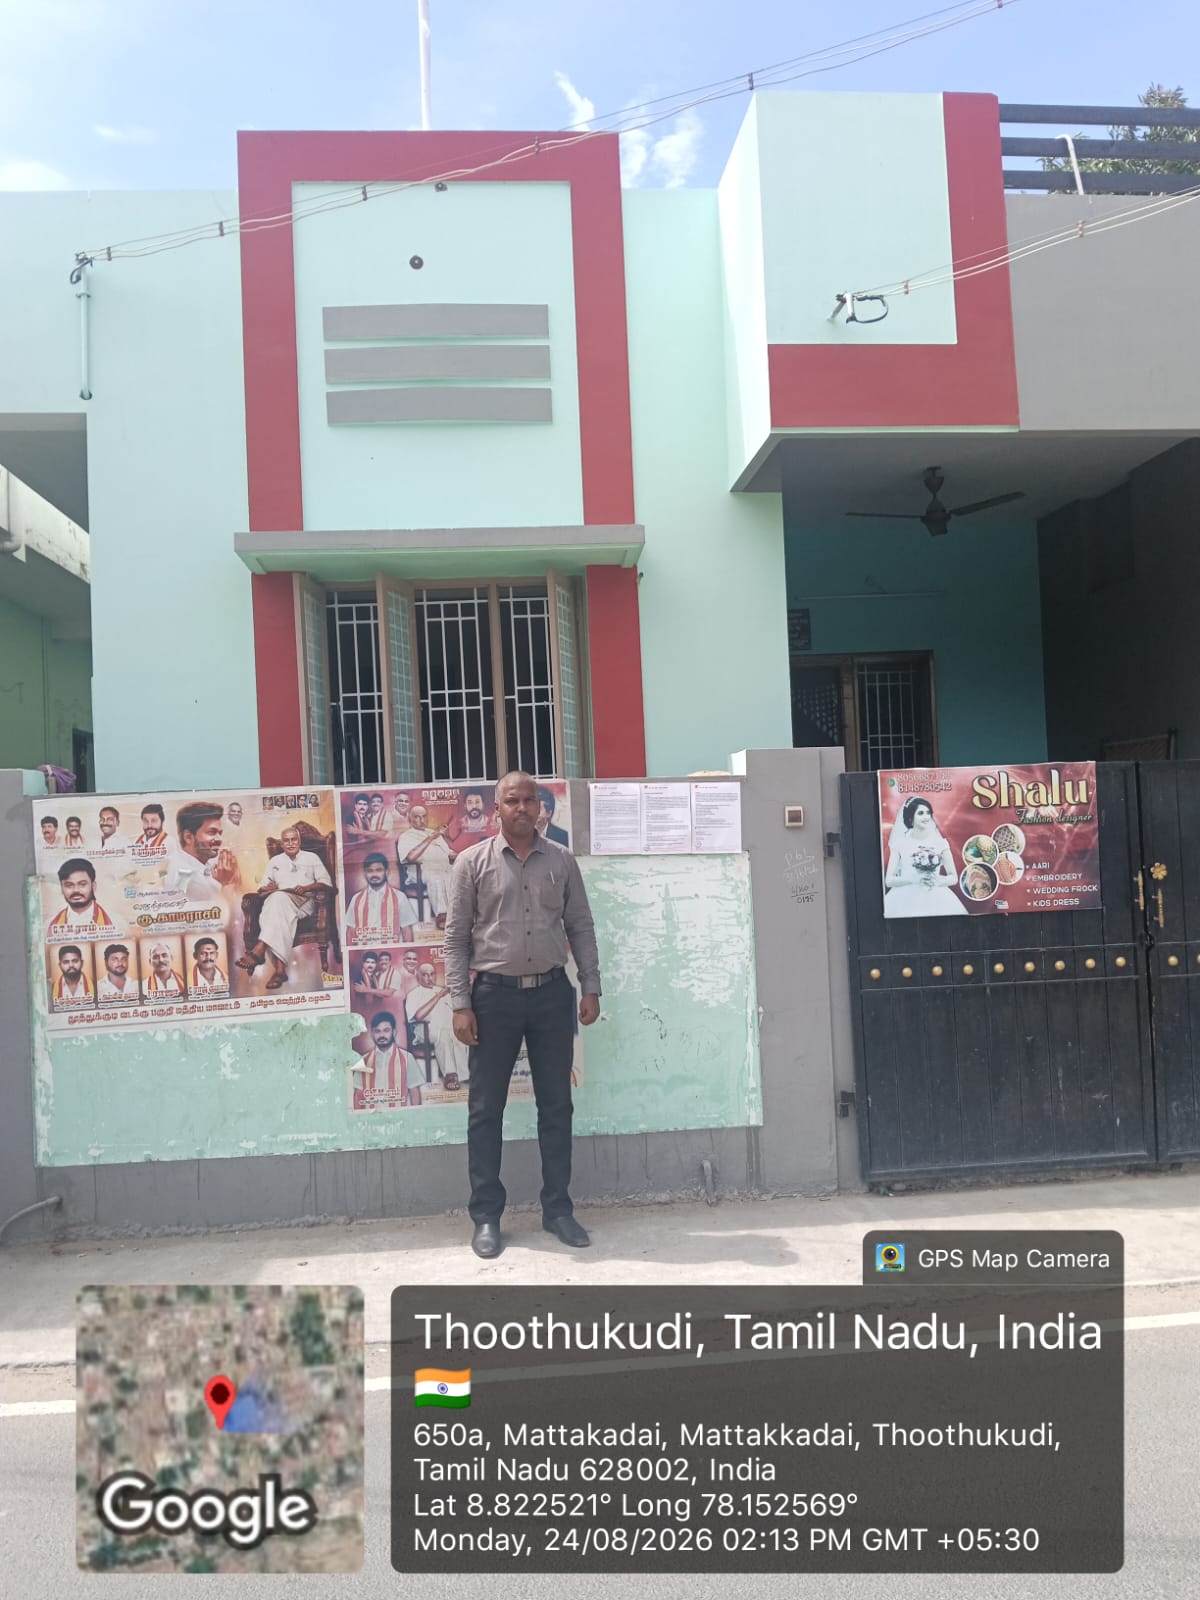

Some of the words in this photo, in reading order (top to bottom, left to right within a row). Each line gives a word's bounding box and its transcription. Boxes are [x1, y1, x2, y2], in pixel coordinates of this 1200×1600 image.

[971, 769, 1089, 810] Shalu
[1015, 807, 1053, 825] Fashion
[1056, 808, 1093, 825] designer
[1031, 862, 1050, 870] AARI
[1031, 873, 1082, 882] EMBROIDERY
[1032, 886, 1070, 895] WEDDING
[1071, 884, 1098, 893] FROCK
[1053, 898, 1080, 906] DRESS
